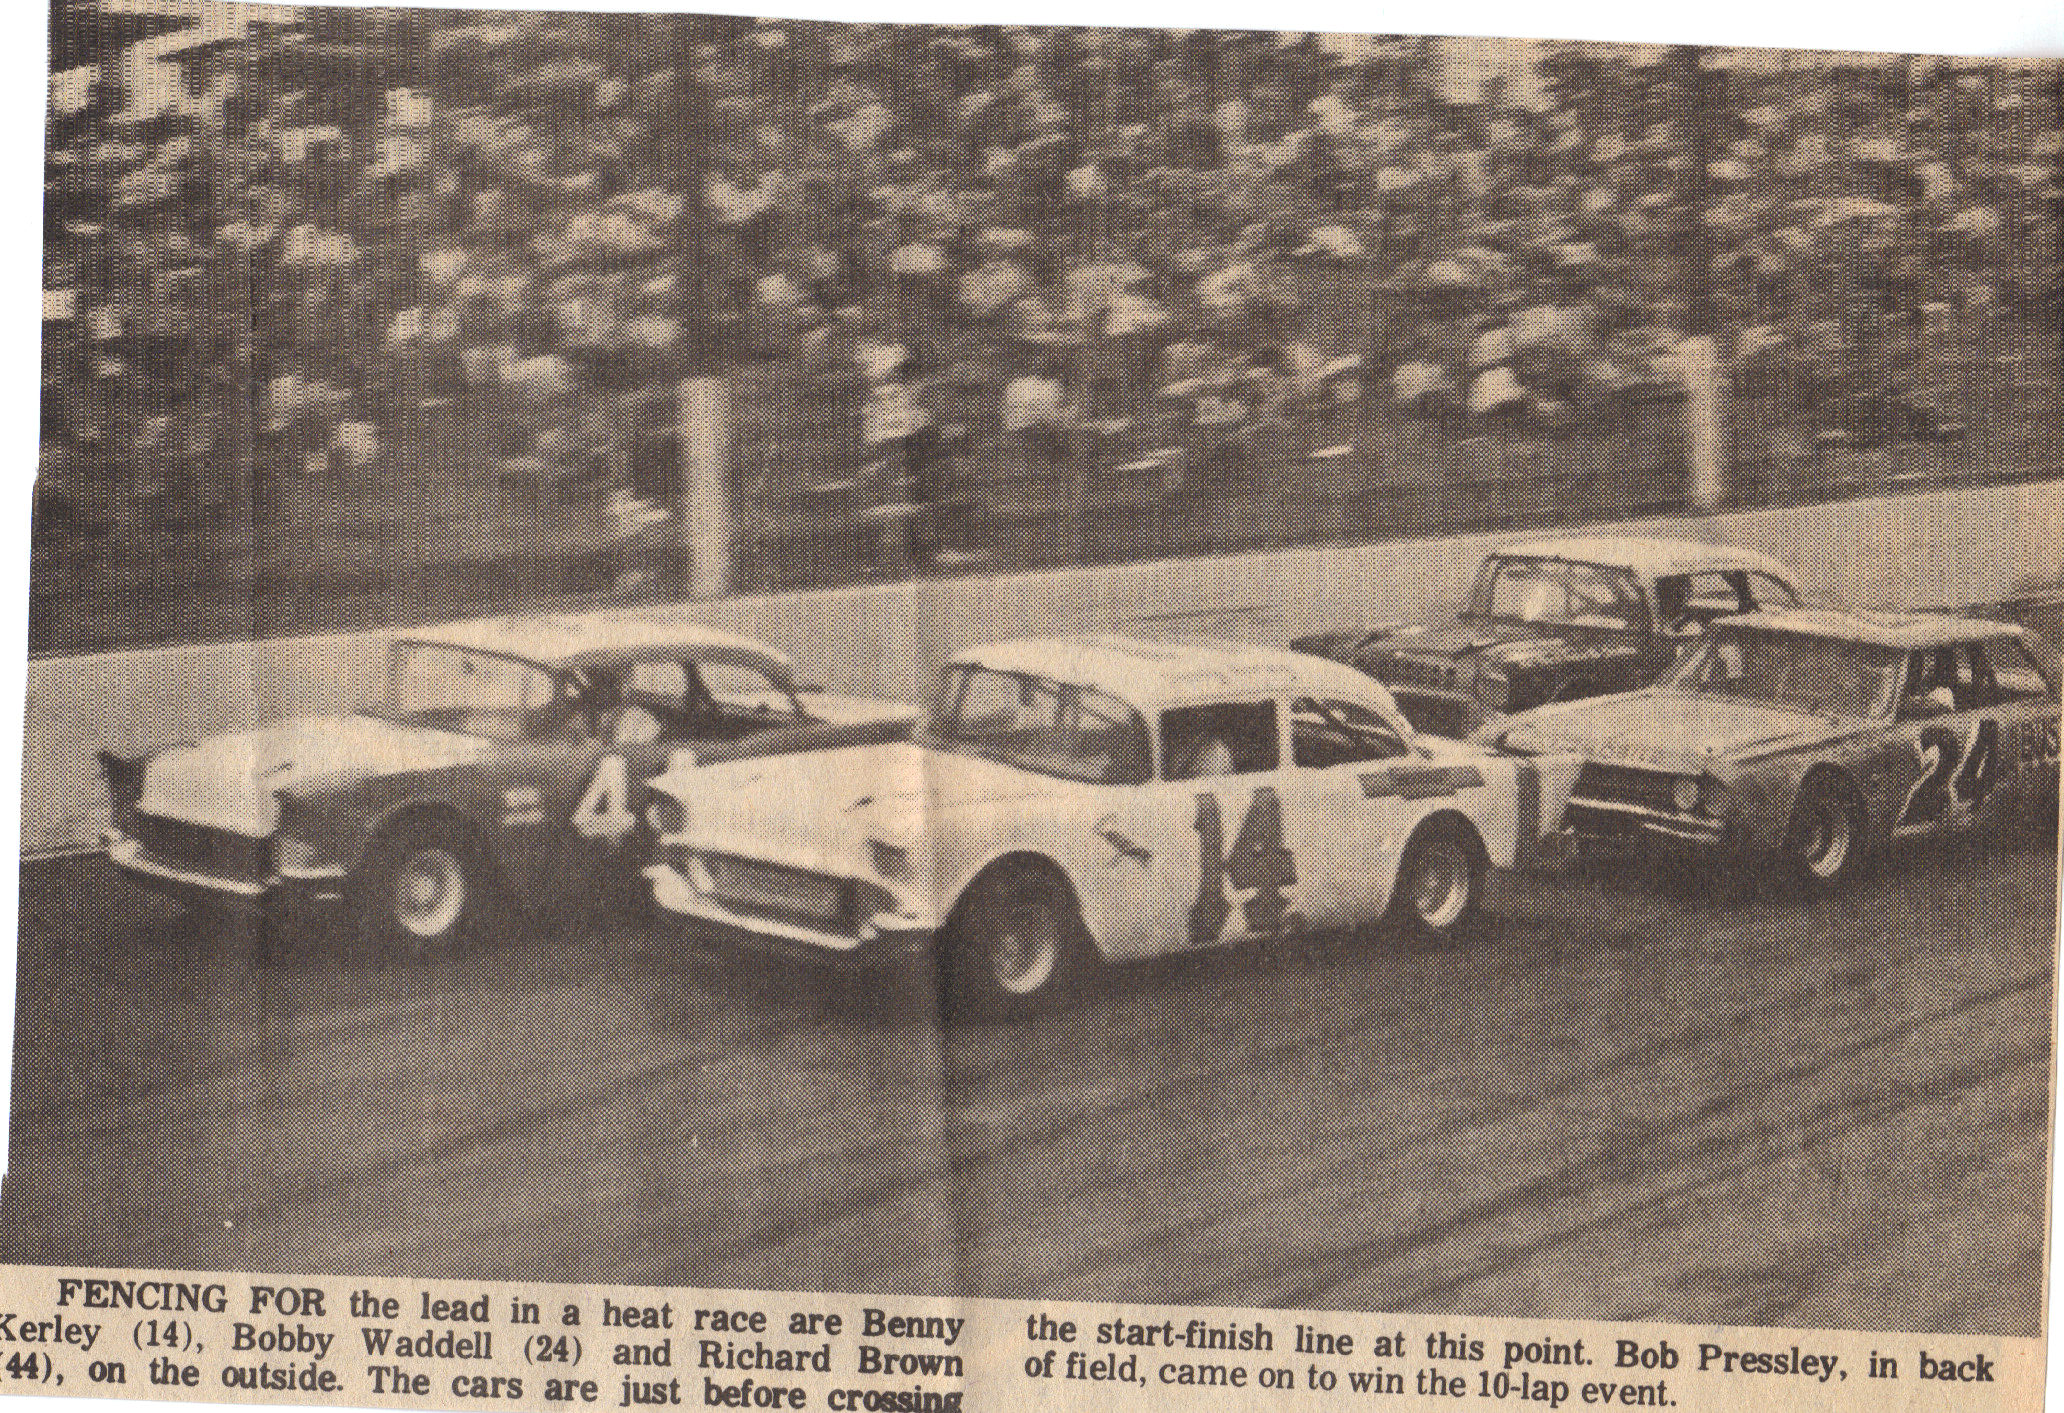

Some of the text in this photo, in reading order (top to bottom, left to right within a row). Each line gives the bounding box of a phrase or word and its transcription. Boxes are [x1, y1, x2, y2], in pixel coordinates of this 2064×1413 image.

[1899, 717, 2000, 835] 24
[1187, 785, 1299, 946] 14
[0, 1314, 963, 1376] Kerley (14), Bobby Waddell (24) and Richard Brown
[57, 1279, 965, 1345] FENCING FOR the lead in a heat race are Benny
[1025, 1350, 1676, 1408] of field, came on to win the 10-lap event.
[1027, 1314, 1993, 1382] the start-finish line at this point. Bob Pressley, in back
[89, 1361, 125, 1383] on
[150, 1357, 199, 1386] the
[222, 1363, 342, 1391] outside.
[368, 1366, 429, 1395] The
[452, 1376, 522, 1398] cars
[545, 1379, 597, 1402] are
[620, 1375, 680, 1406] just
[705, 1377, 806, 1409] before
[828, 1385, 963, 1413] crossing
